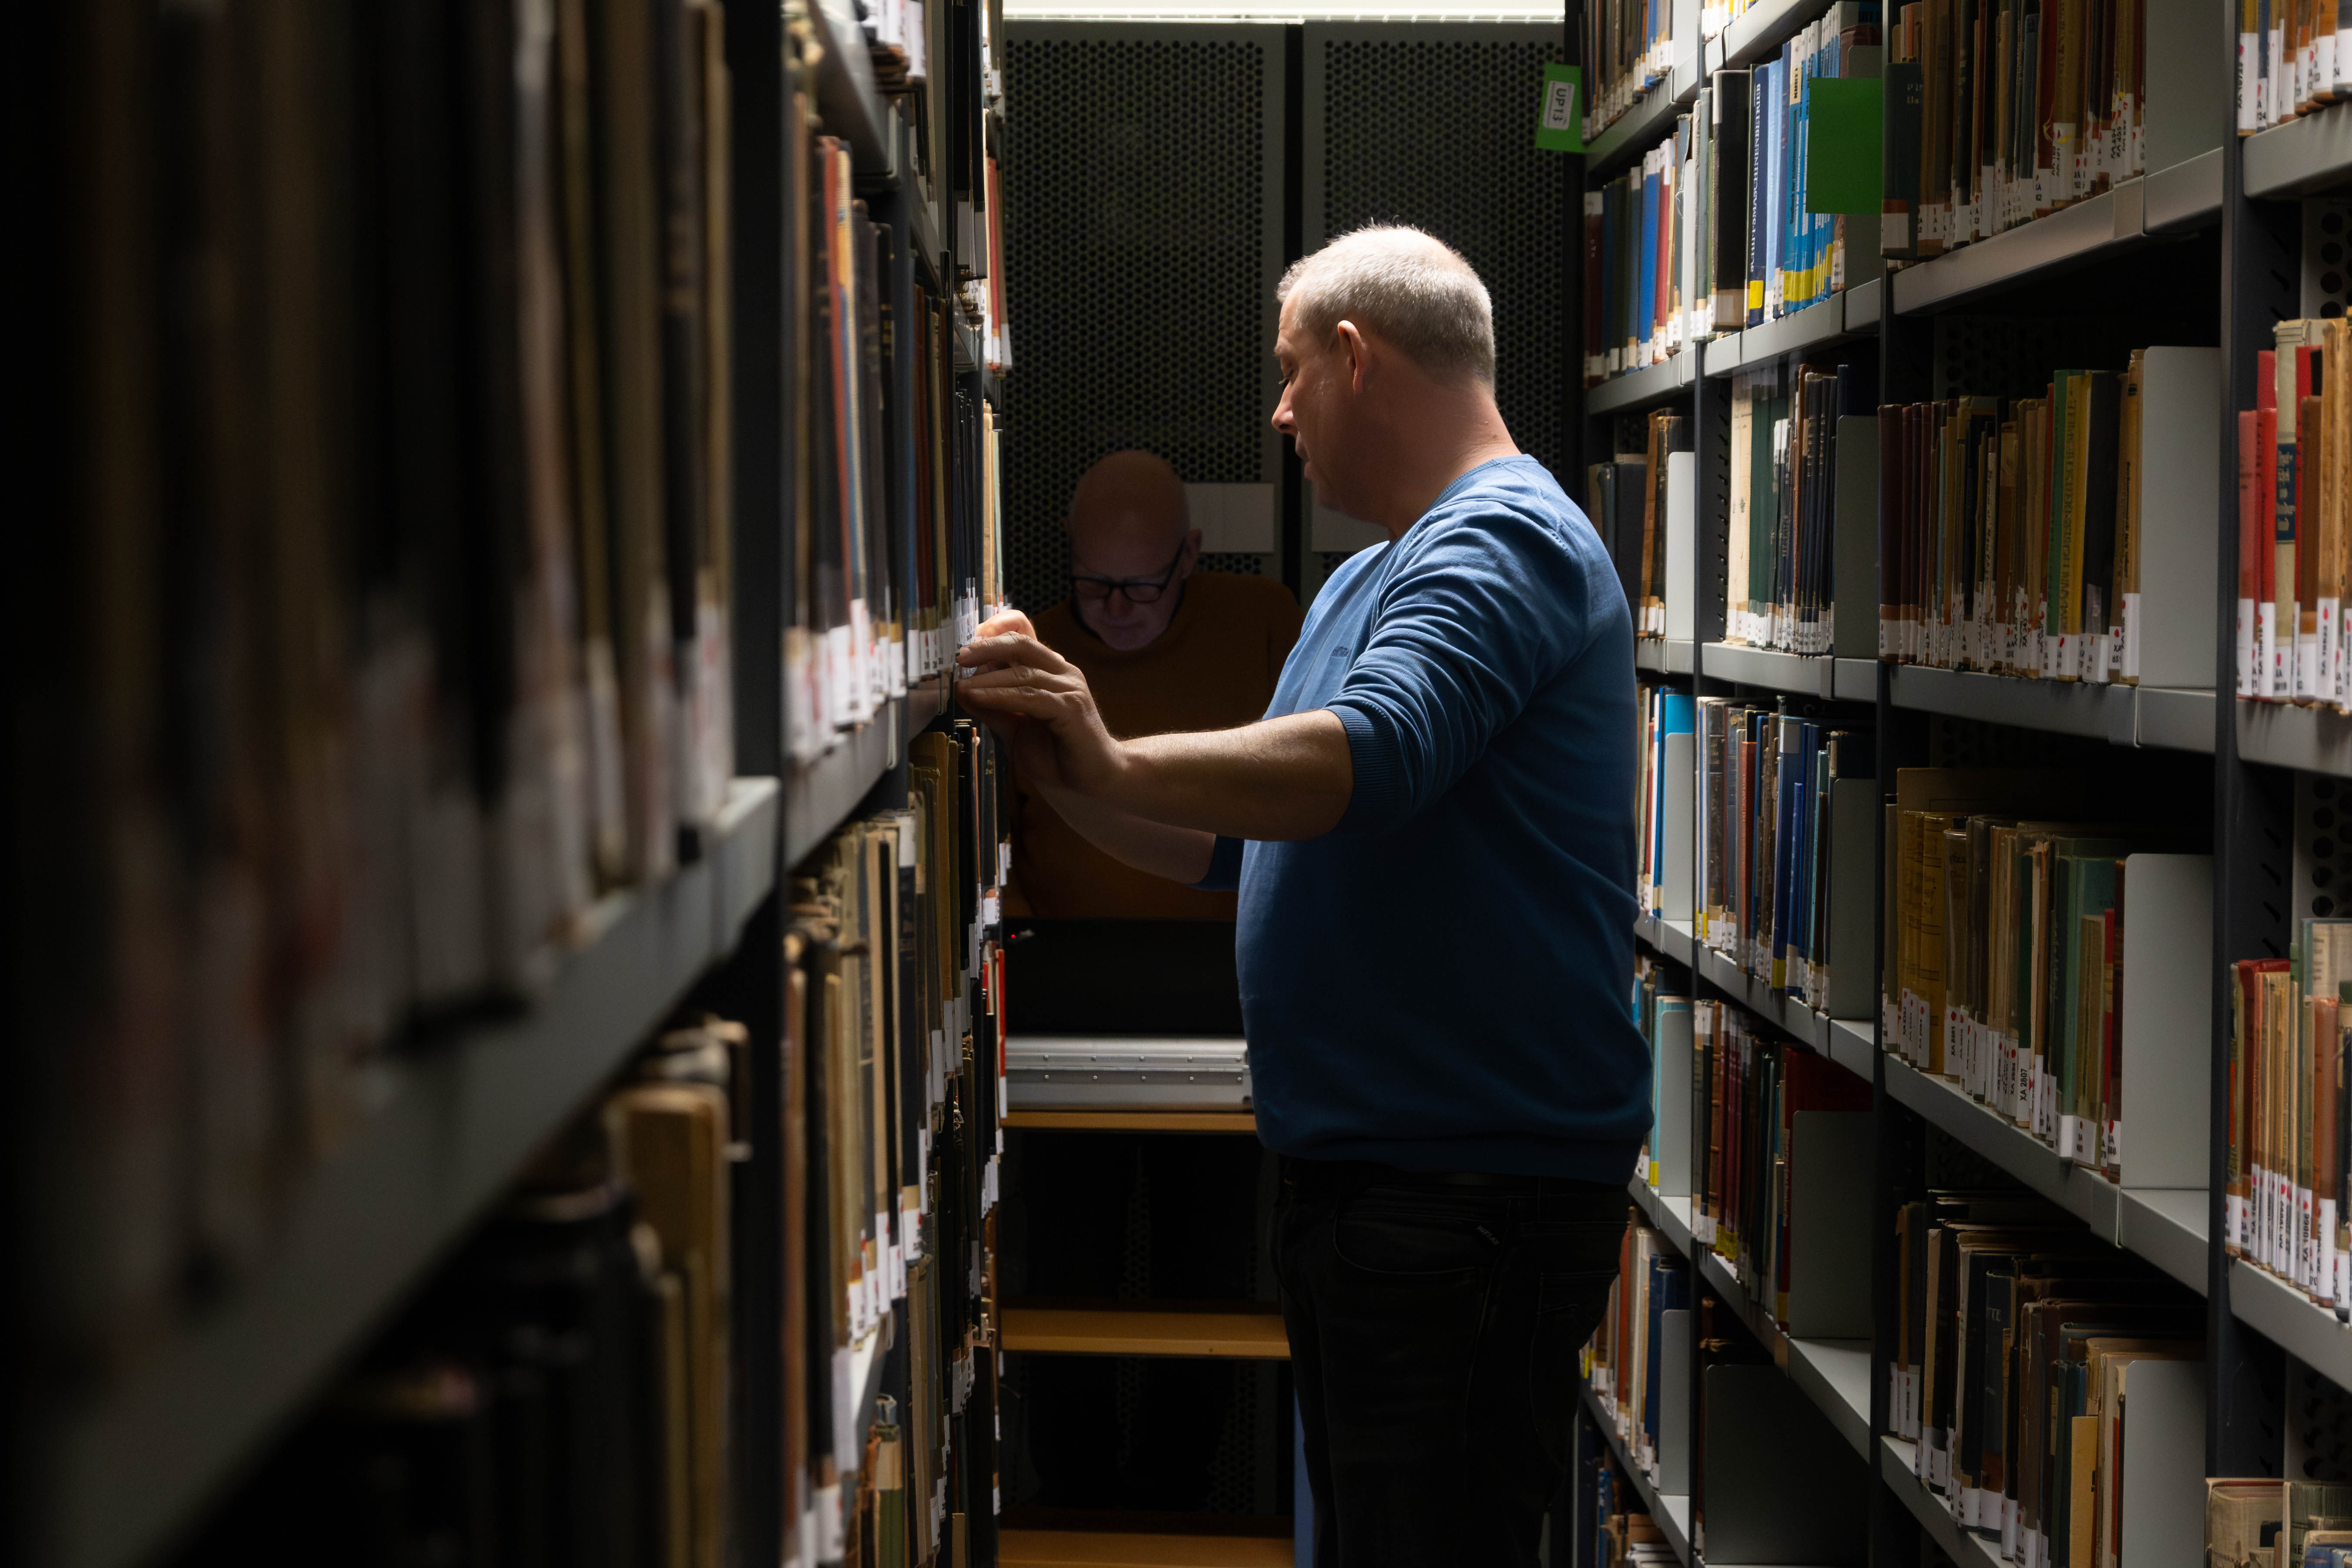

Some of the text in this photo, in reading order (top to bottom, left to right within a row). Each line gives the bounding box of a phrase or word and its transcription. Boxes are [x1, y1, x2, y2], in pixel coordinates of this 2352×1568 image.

[1553, 88, 1567, 122] UP13
[2020, 1089, 2027, 1101] XA
[2302, 1248, 2308, 1262] XA
